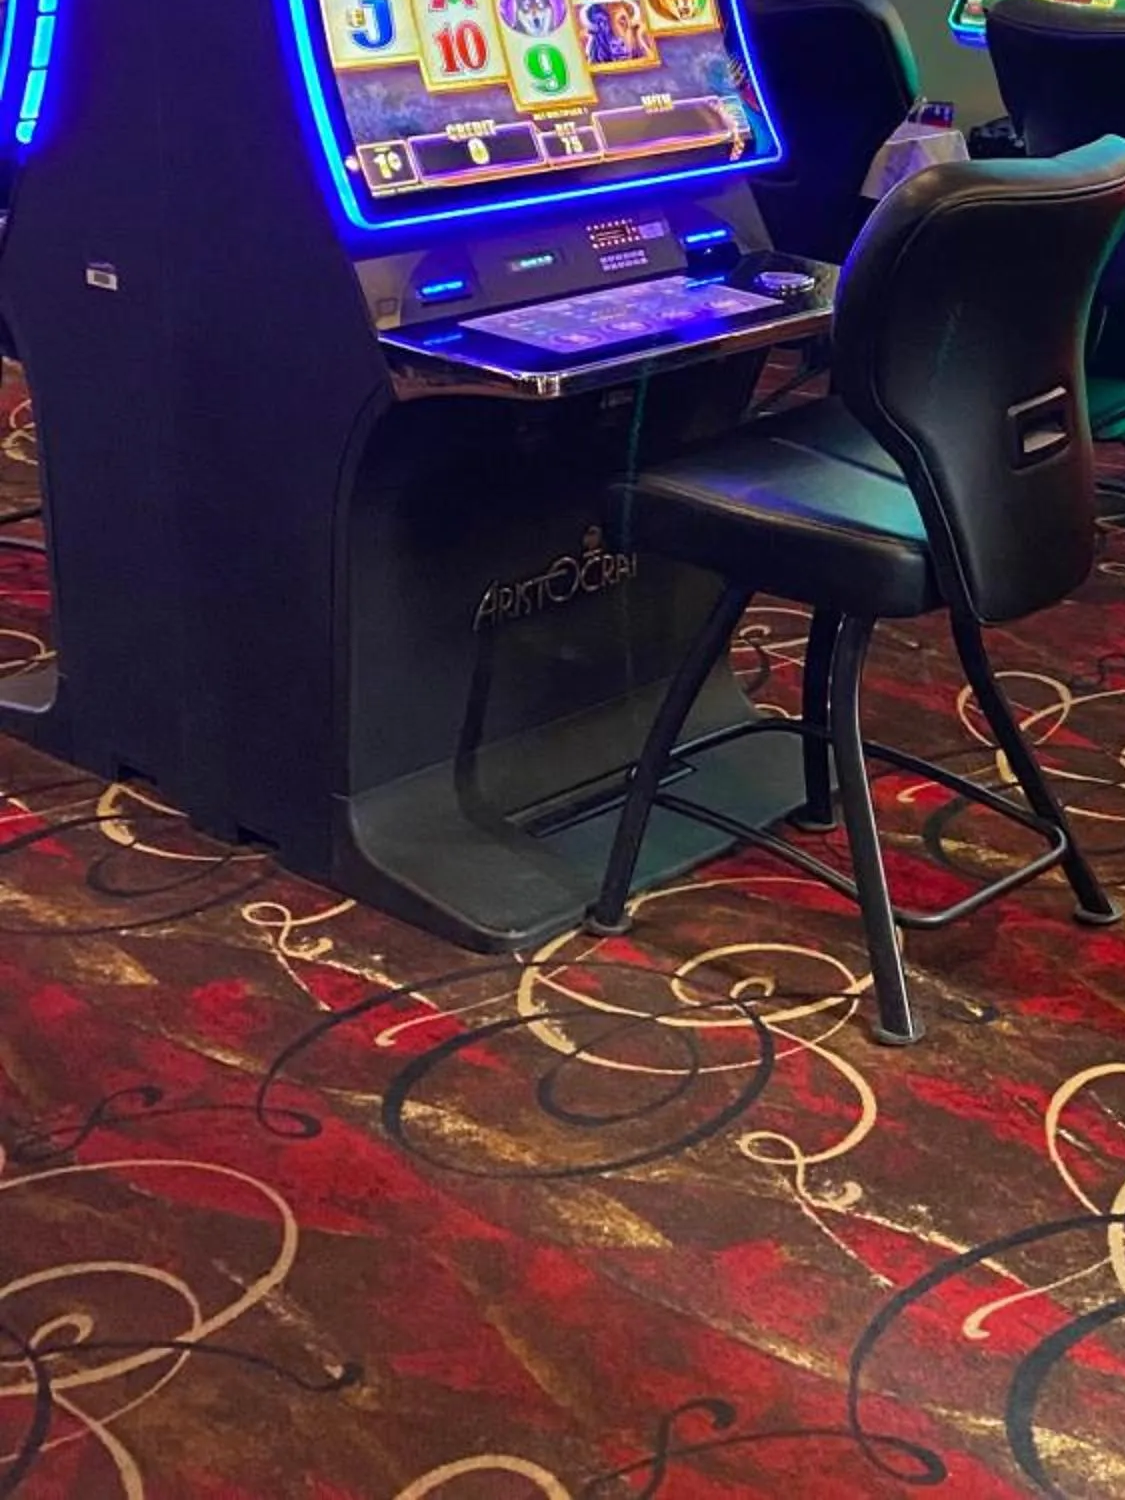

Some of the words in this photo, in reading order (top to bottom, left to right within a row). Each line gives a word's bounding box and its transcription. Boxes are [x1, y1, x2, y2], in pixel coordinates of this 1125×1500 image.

[435, 19, 489, 76] 10
[524, 43, 569, 94] 9
[445, 118, 497, 141] CREDIT
